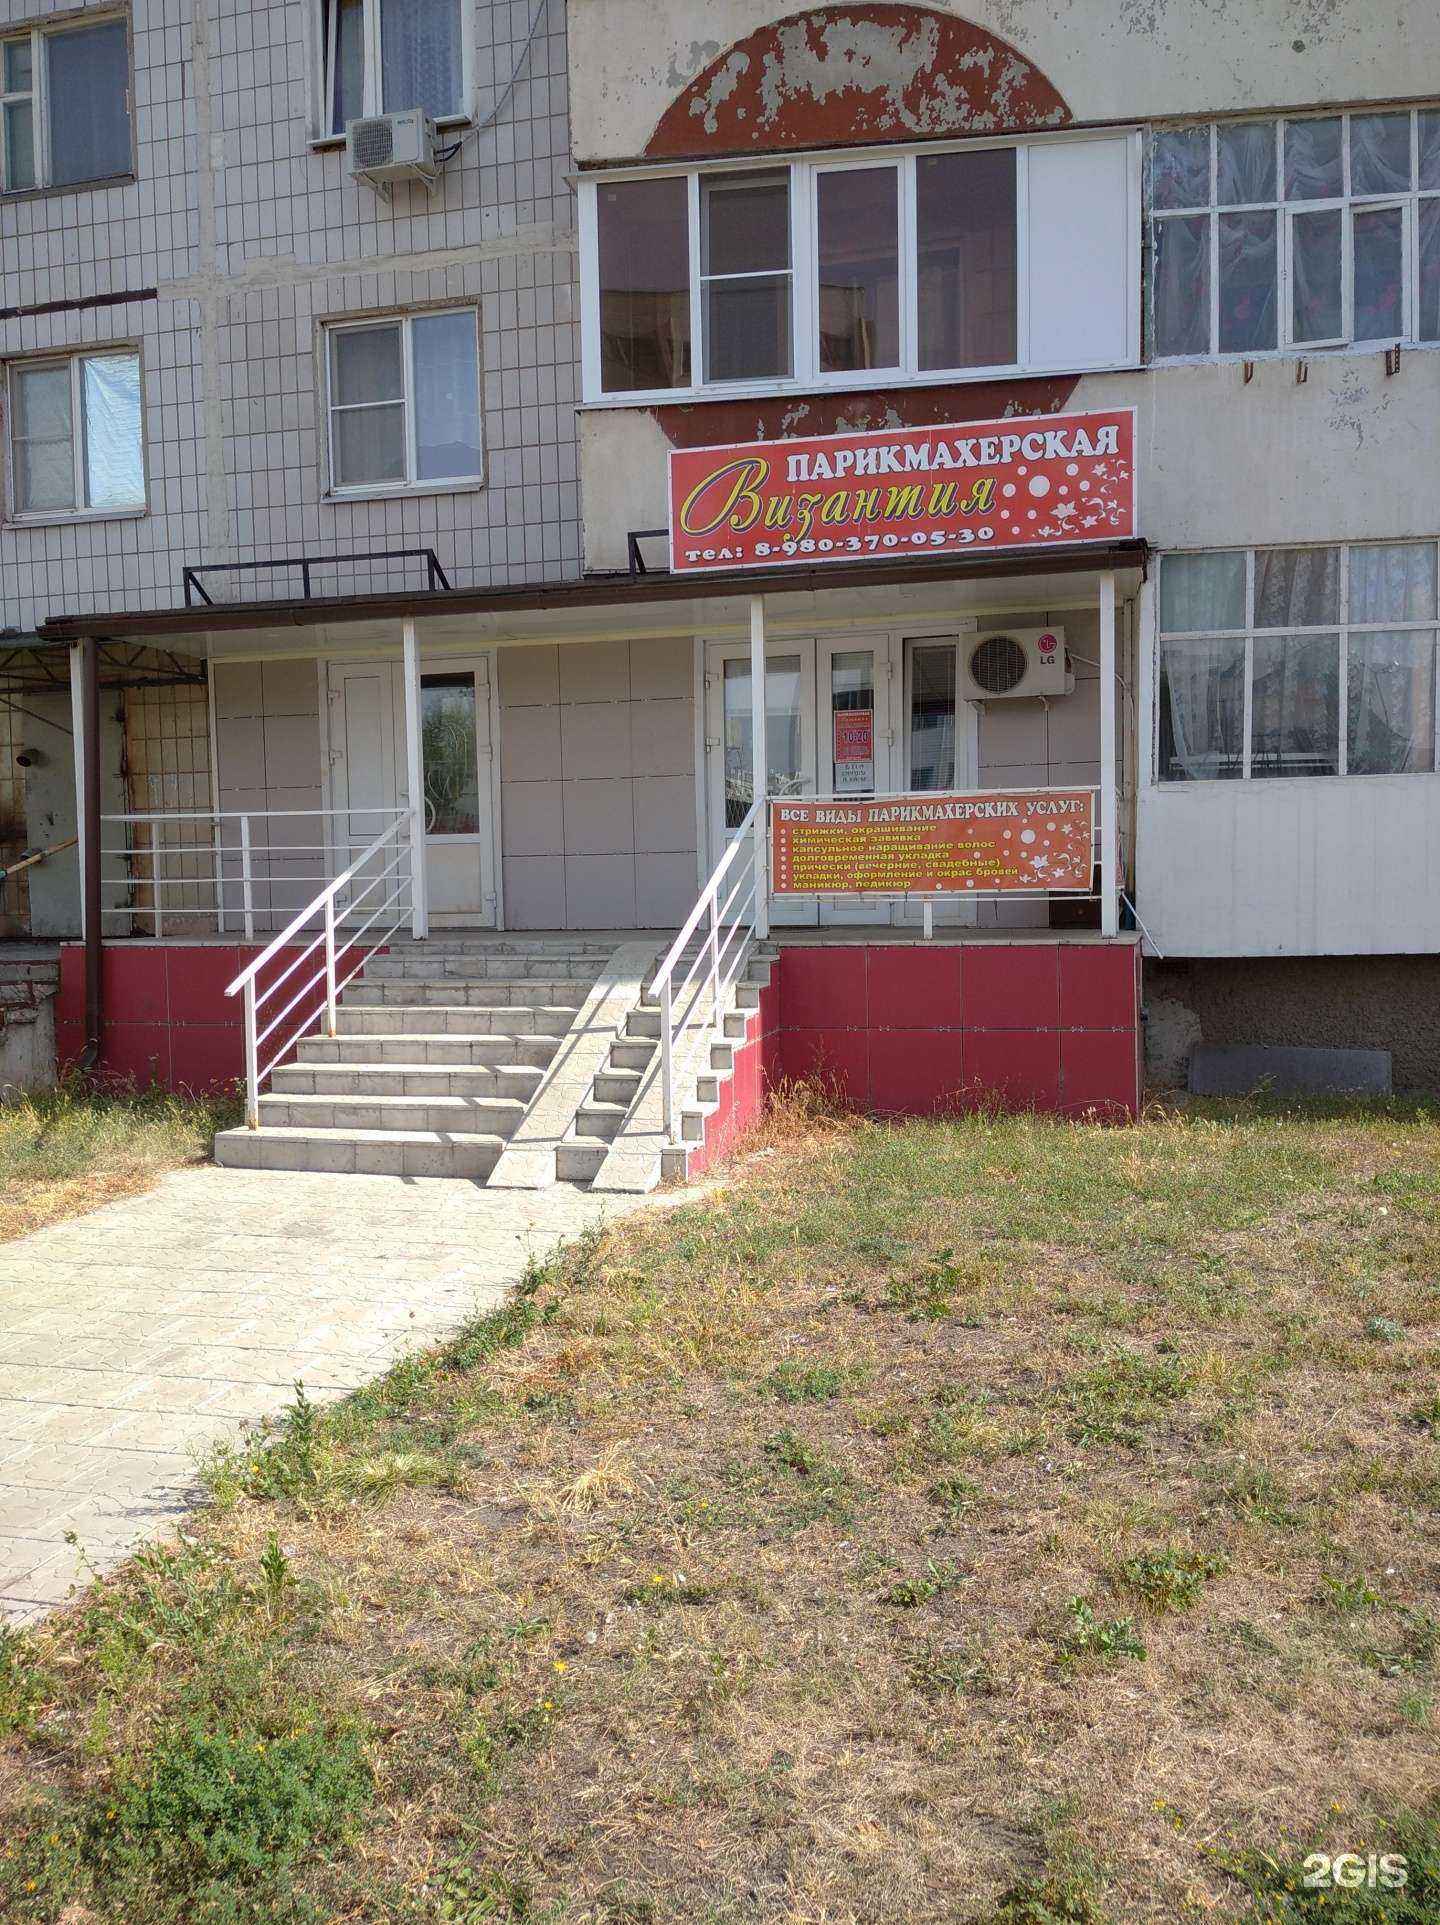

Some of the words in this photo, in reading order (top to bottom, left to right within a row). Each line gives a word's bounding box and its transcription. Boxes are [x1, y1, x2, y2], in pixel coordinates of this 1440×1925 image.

[786, 425, 1120, 483] ПАРИКМАХЕРСКАЯ
[679, 457, 998, 542] Византия
[686, 545, 744, 562] тел:
[754, 528, 995, 557] 8-980-370-05-30
[1040, 656, 1055, 664] LG
[781, 808, 809, 821] ВСЕ
[815, 808, 862, 824] ВИДЫ
[868, 802, 1019, 822] ПАРИКМАХЕРСКИХ
[1026, 799, 1085, 816] УСЛУГ:
[792, 828, 847, 836] стрижки,
[851, 825, 937, 834] окрашивание
[792, 836, 867, 844] химическая
[870, 834, 921, 842] завивка
[792, 845, 864, 853] капсульное
[868, 843, 954, 851] наращивание
[792, 853, 895, 863] долговременная
[898, 852, 949, 861] укладка
[792, 863, 851, 871] прически
[925, 859, 1000, 868] свадебные)
[793, 872, 844, 881] укладки,
[847, 870, 923, 879] оформление
[936, 869, 972, 877] окрас
[976, 867, 1018, 876] бровей
[855, 880, 911, 888] педикюр
